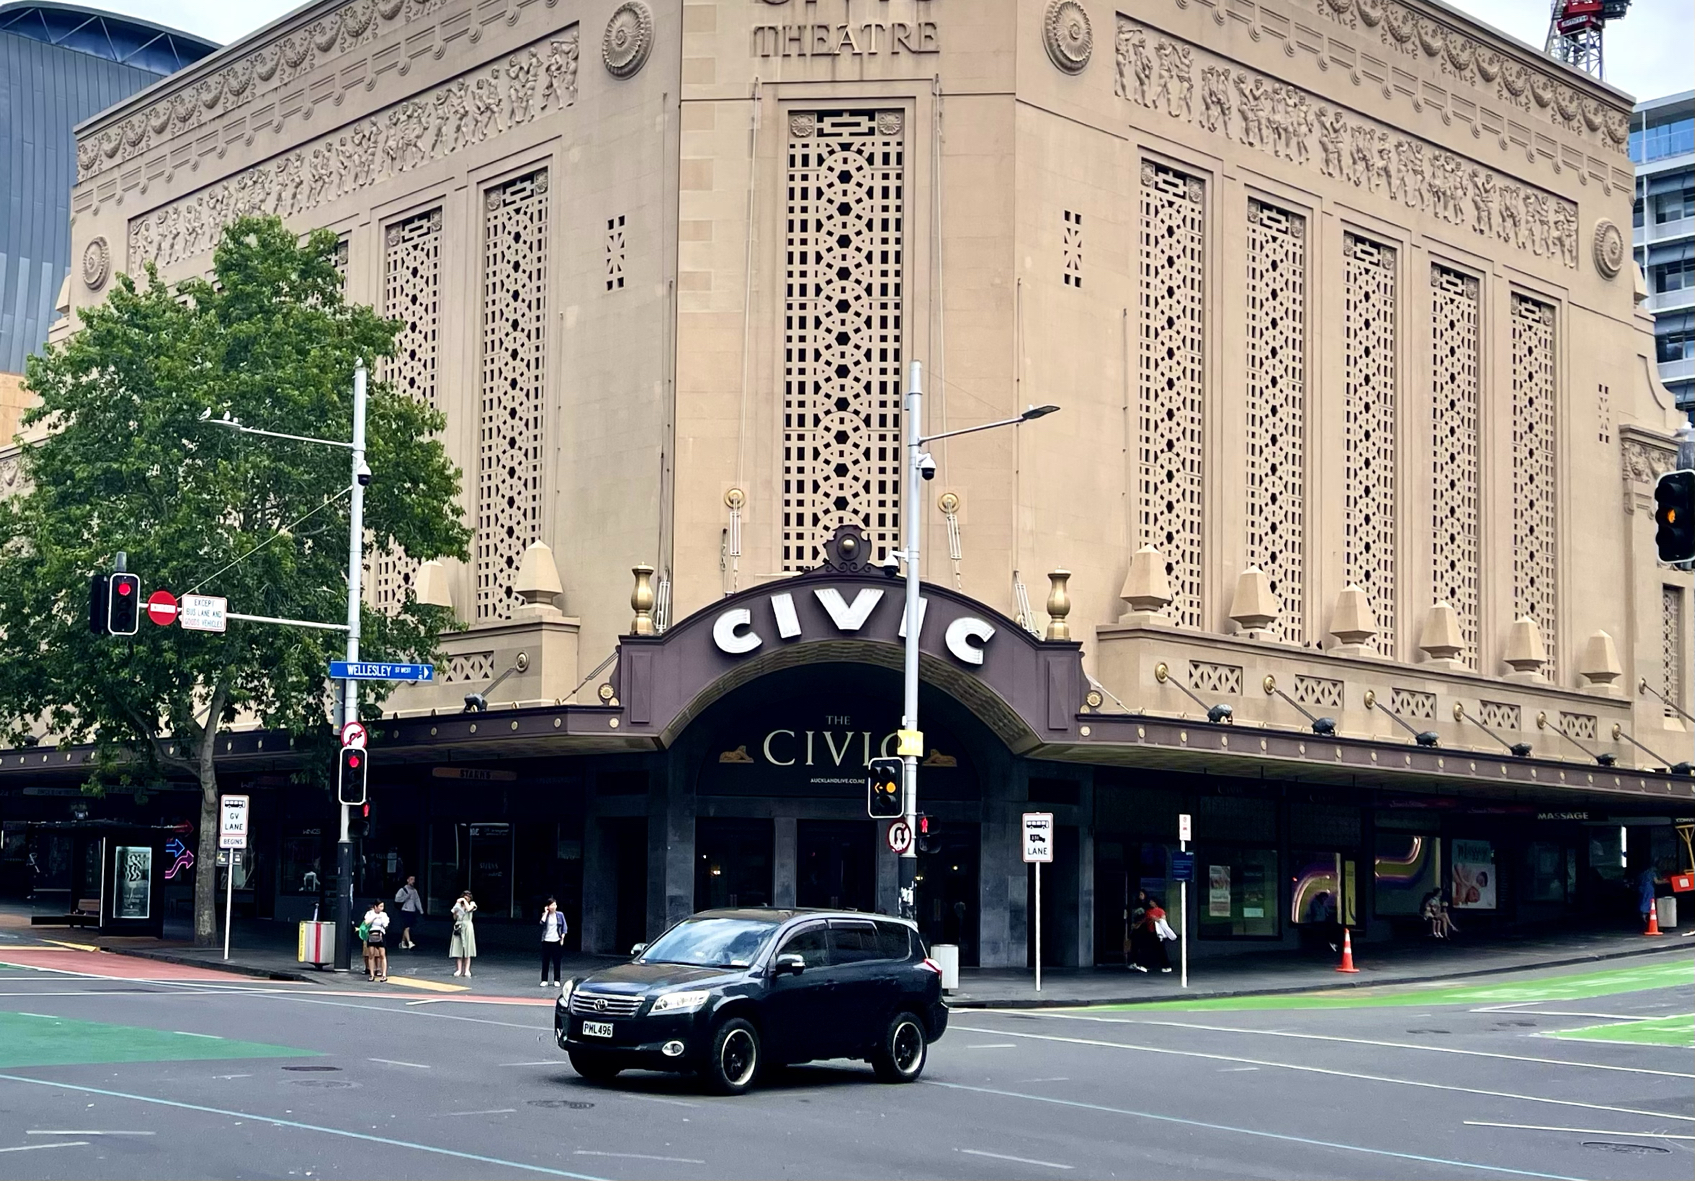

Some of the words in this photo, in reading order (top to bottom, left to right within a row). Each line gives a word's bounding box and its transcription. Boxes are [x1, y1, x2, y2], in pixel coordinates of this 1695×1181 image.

[754, 22, 941, 57] THEATRE
[194, 598, 215, 607] EXCEPT
[186, 608, 197, 616] BUS
[197, 609, 210, 617] LANE
[212, 610, 222, 619] AND
[185, 618, 200, 626] GOODS
[201, 619, 223, 628] VEHICLES
[347, 664, 392, 677] WELLESLEY
[826, 715, 851, 726] THE
[229, 812, 240, 820] GV
[1537, 812, 1589, 821] MASSAGE
[224, 823, 243, 831] LANE
[1027, 847, 1048, 856] LANE
